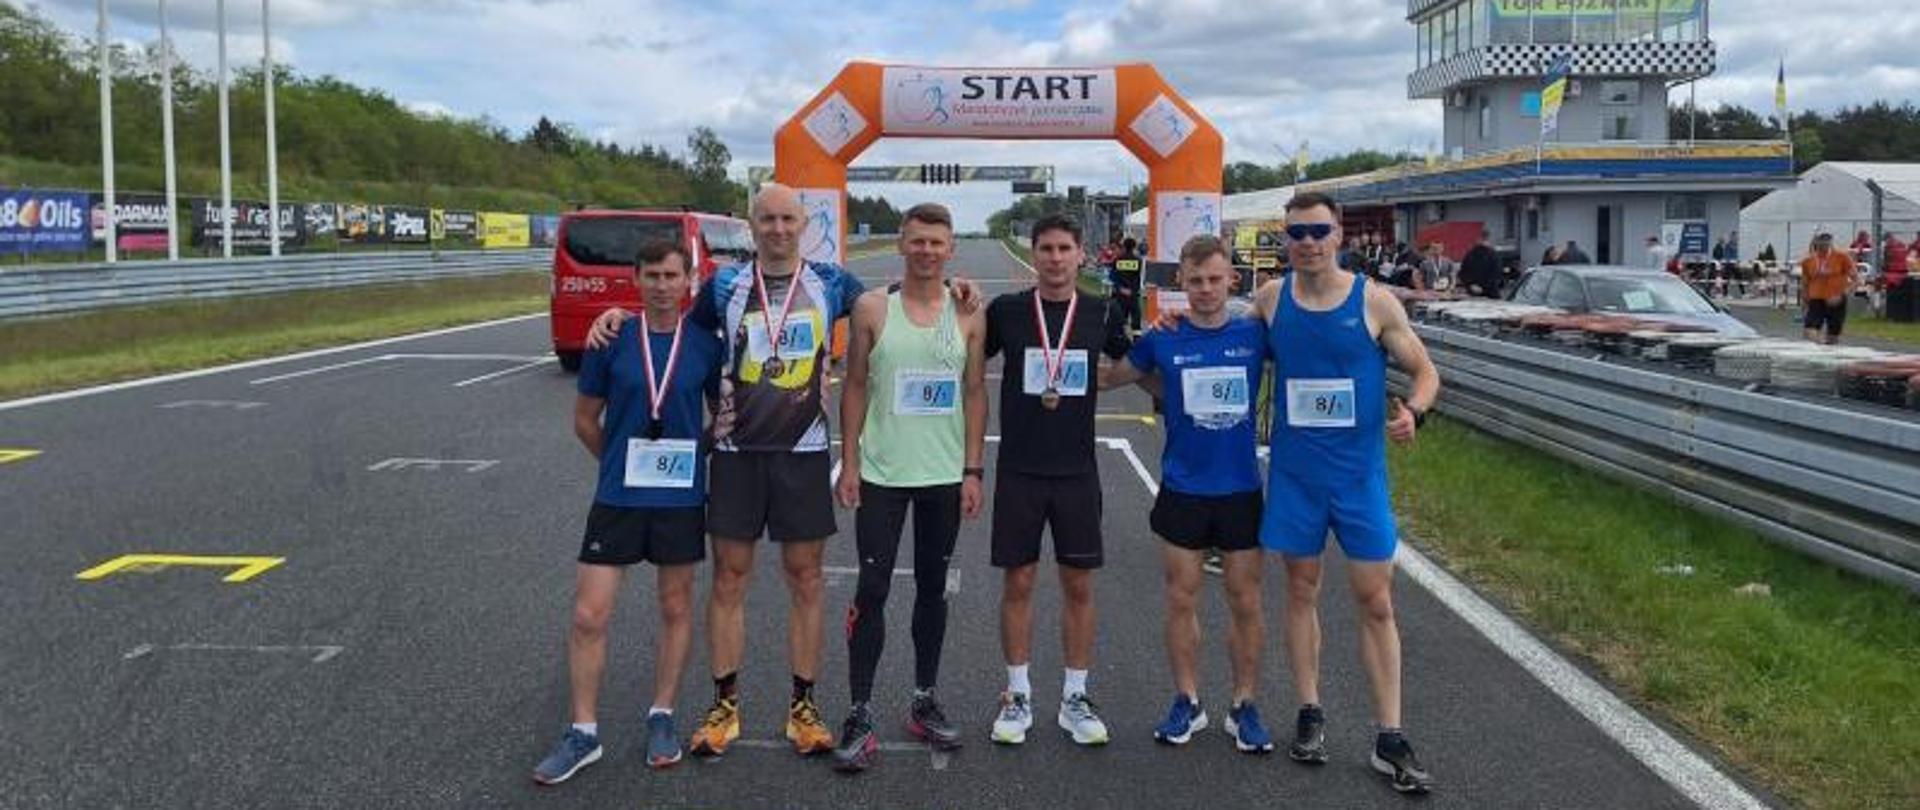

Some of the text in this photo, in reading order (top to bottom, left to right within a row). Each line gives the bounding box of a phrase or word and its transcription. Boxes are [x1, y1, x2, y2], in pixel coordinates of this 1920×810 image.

[961, 74, 1098, 101] START
[0, 199, 82, 228] 8 Oils
